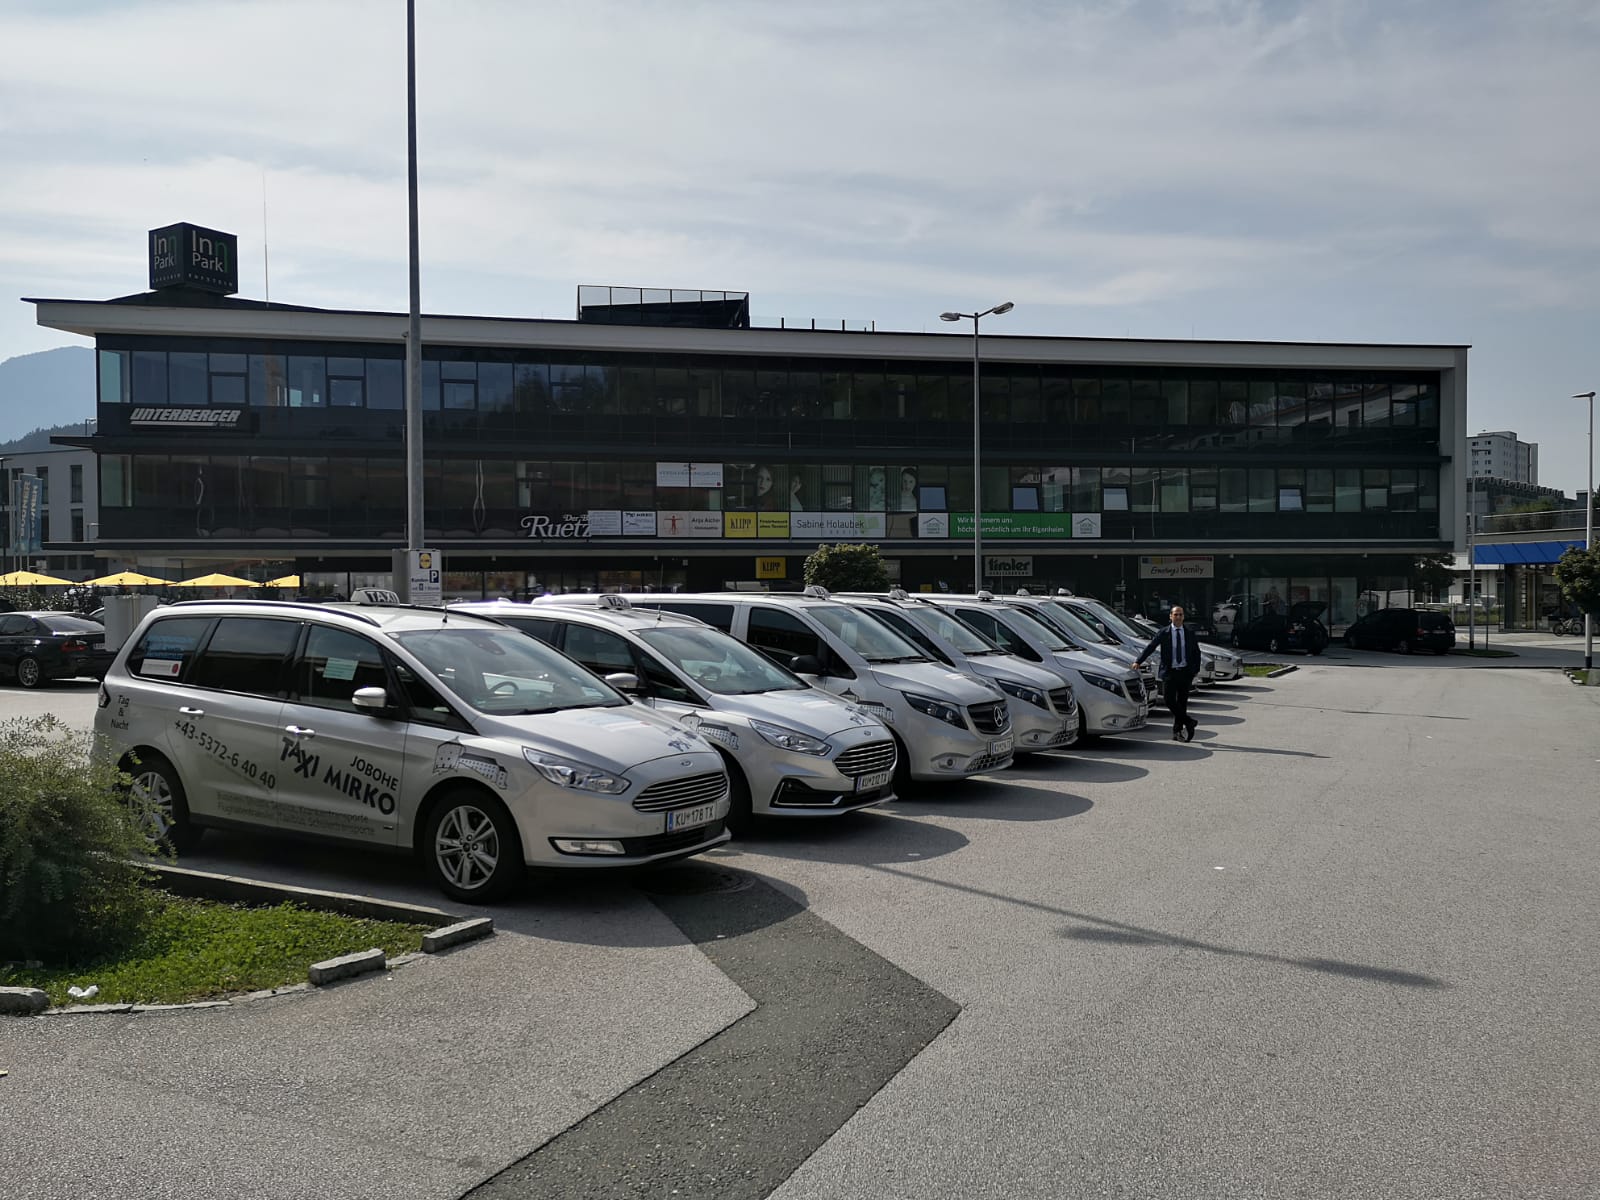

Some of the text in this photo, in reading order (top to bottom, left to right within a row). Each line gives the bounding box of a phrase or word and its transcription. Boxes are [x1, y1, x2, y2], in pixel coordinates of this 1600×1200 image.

[192, 230, 228, 273] Inn
[154, 252, 175, 270] Park
[192, 252, 224, 273] Park
[129, 407, 241, 422] UNTERBERGER
[520, 515, 592, 538] Ruetz
[730, 518, 752, 529] KLIPP
[796, 519, 865, 529] Sabine Holaubek
[957, 516, 969, 524] Wir
[970, 516, 1001, 524] kmmern
[431, 571, 438, 582] P
[1180, 565, 1205, 575] family
[366, 591, 398, 603] TAXI
[118, 695, 130, 707] Tag
[118, 708, 124, 717] &
[110, 718, 129, 731] Nacht
[175, 719, 276, 790] +43-5372-6 40 40
[280, 736, 320, 778] TAXI
[323, 764, 396, 815] MIRKO
[350, 755, 399, 791] JOBOHE
